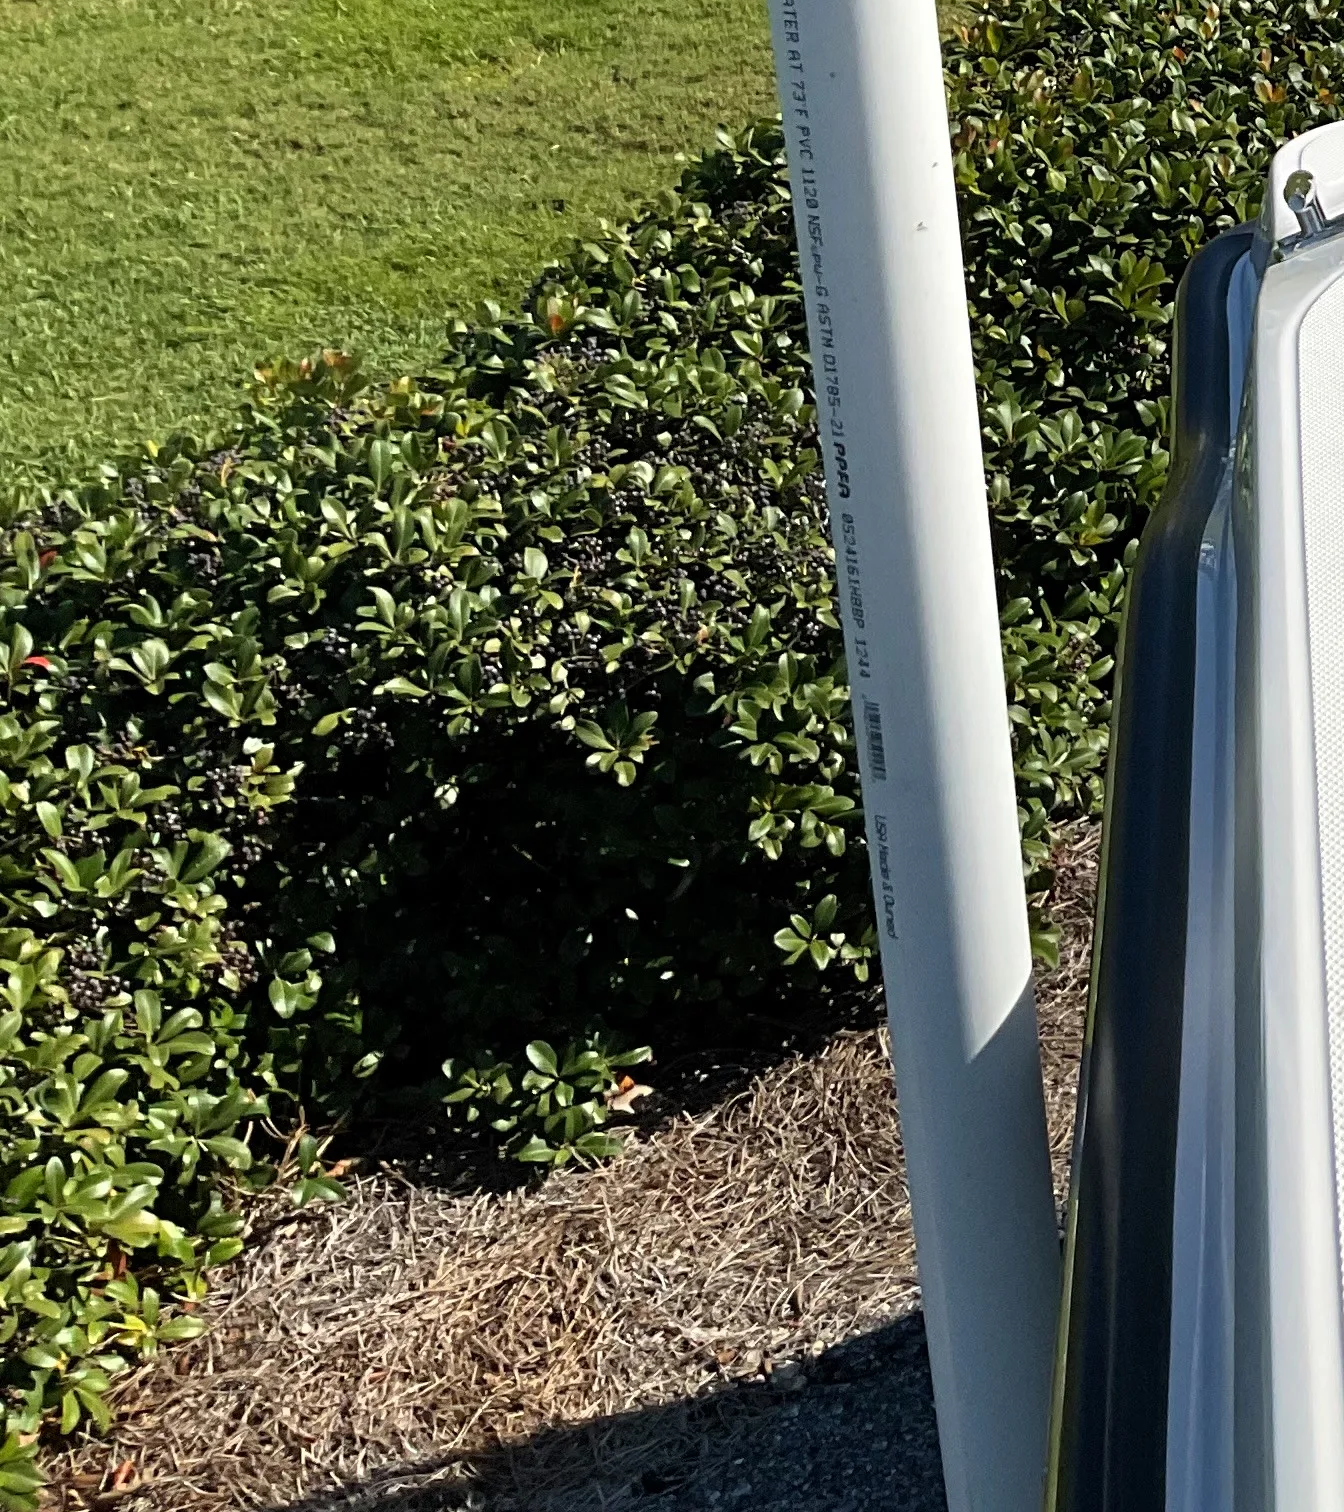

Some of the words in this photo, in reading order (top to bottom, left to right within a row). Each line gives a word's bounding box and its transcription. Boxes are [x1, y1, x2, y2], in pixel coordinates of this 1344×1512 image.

[785, 49, 804, 74] AT
[794, 125, 814, 162] PVC
[800, 167, 819, 210] 1120
[806, 214, 824, 248] NSF
[815, 303, 835, 350] ASTM
[832, 441, 851, 500] PPFA
